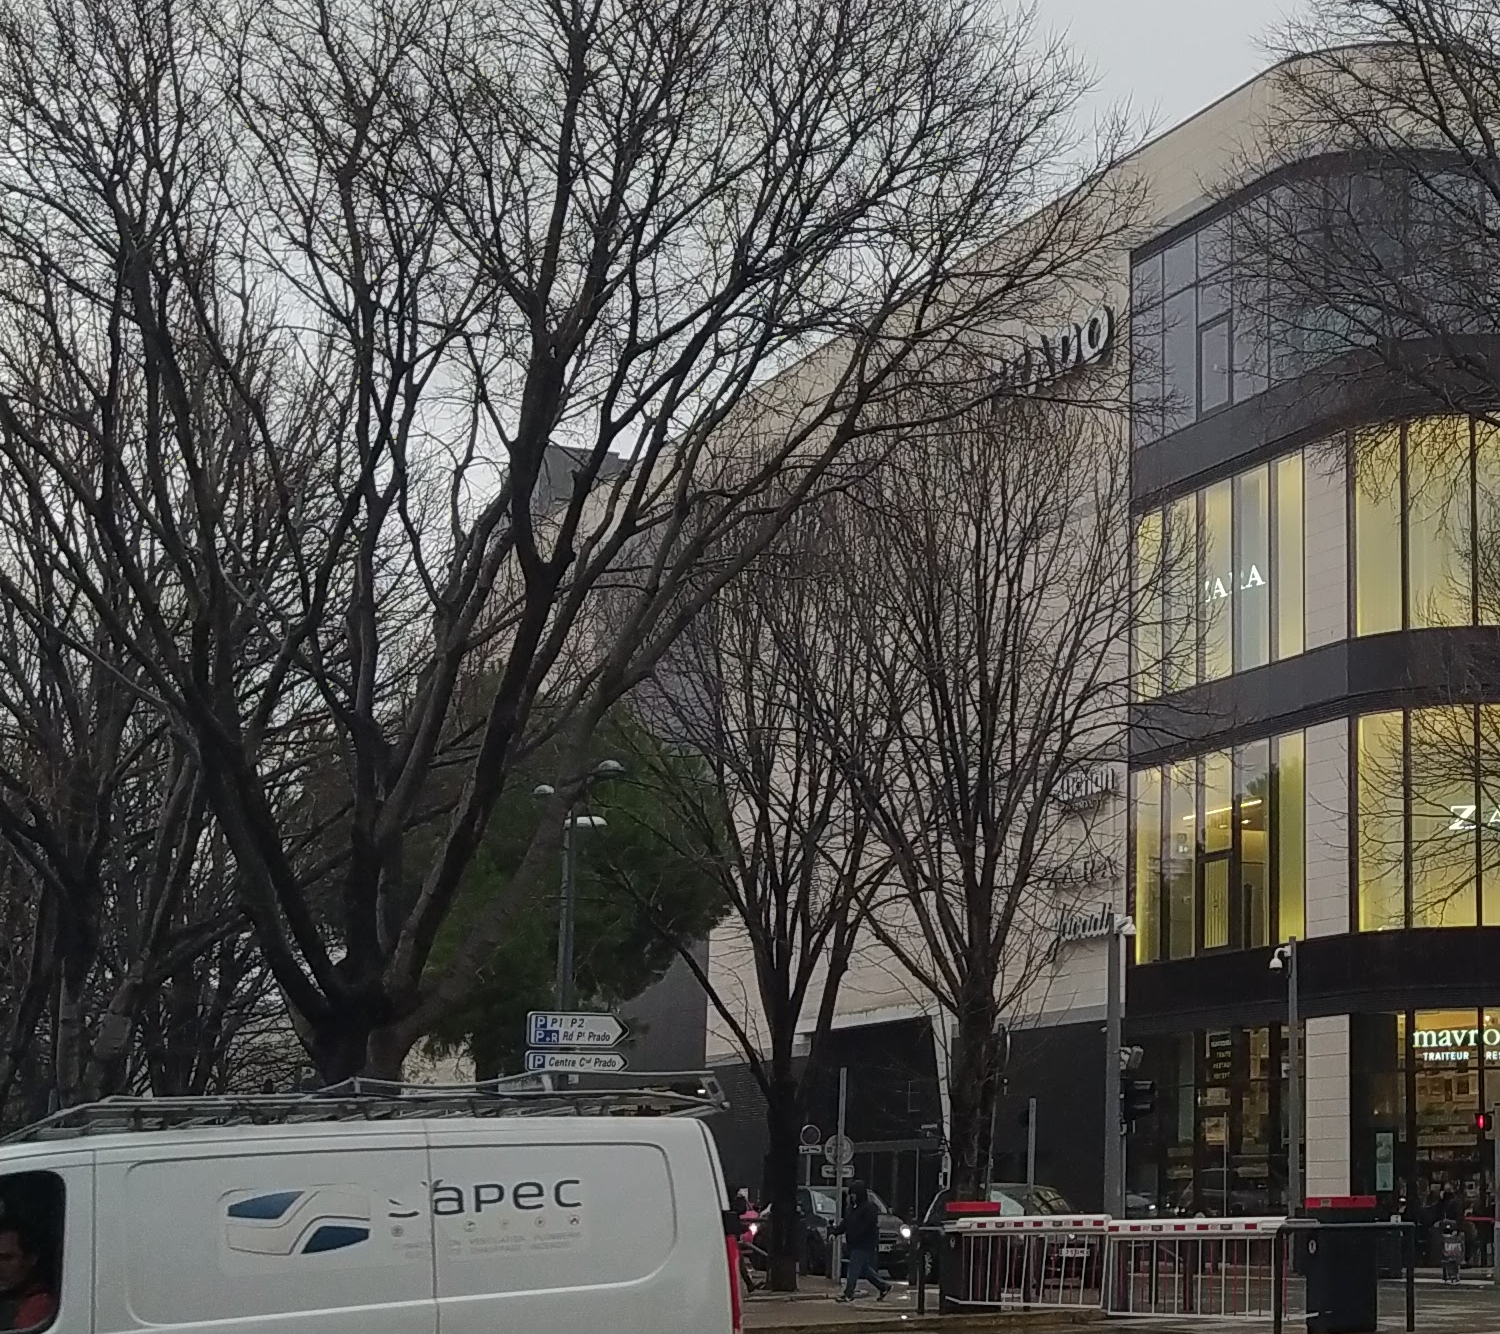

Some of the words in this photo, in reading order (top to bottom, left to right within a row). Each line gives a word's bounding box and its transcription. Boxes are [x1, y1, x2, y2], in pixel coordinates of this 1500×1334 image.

[1203, 564, 1266, 603] AA
[551, 1018, 563, 1028] P1
[570, 1018, 585, 1028] P2
[588, 1032, 611, 1042] Prado
[1423, 1051, 1469, 1061] TRAITEUR
[548, 1057, 576, 1067] Centre
[594, 1058, 617, 1068] Prado
